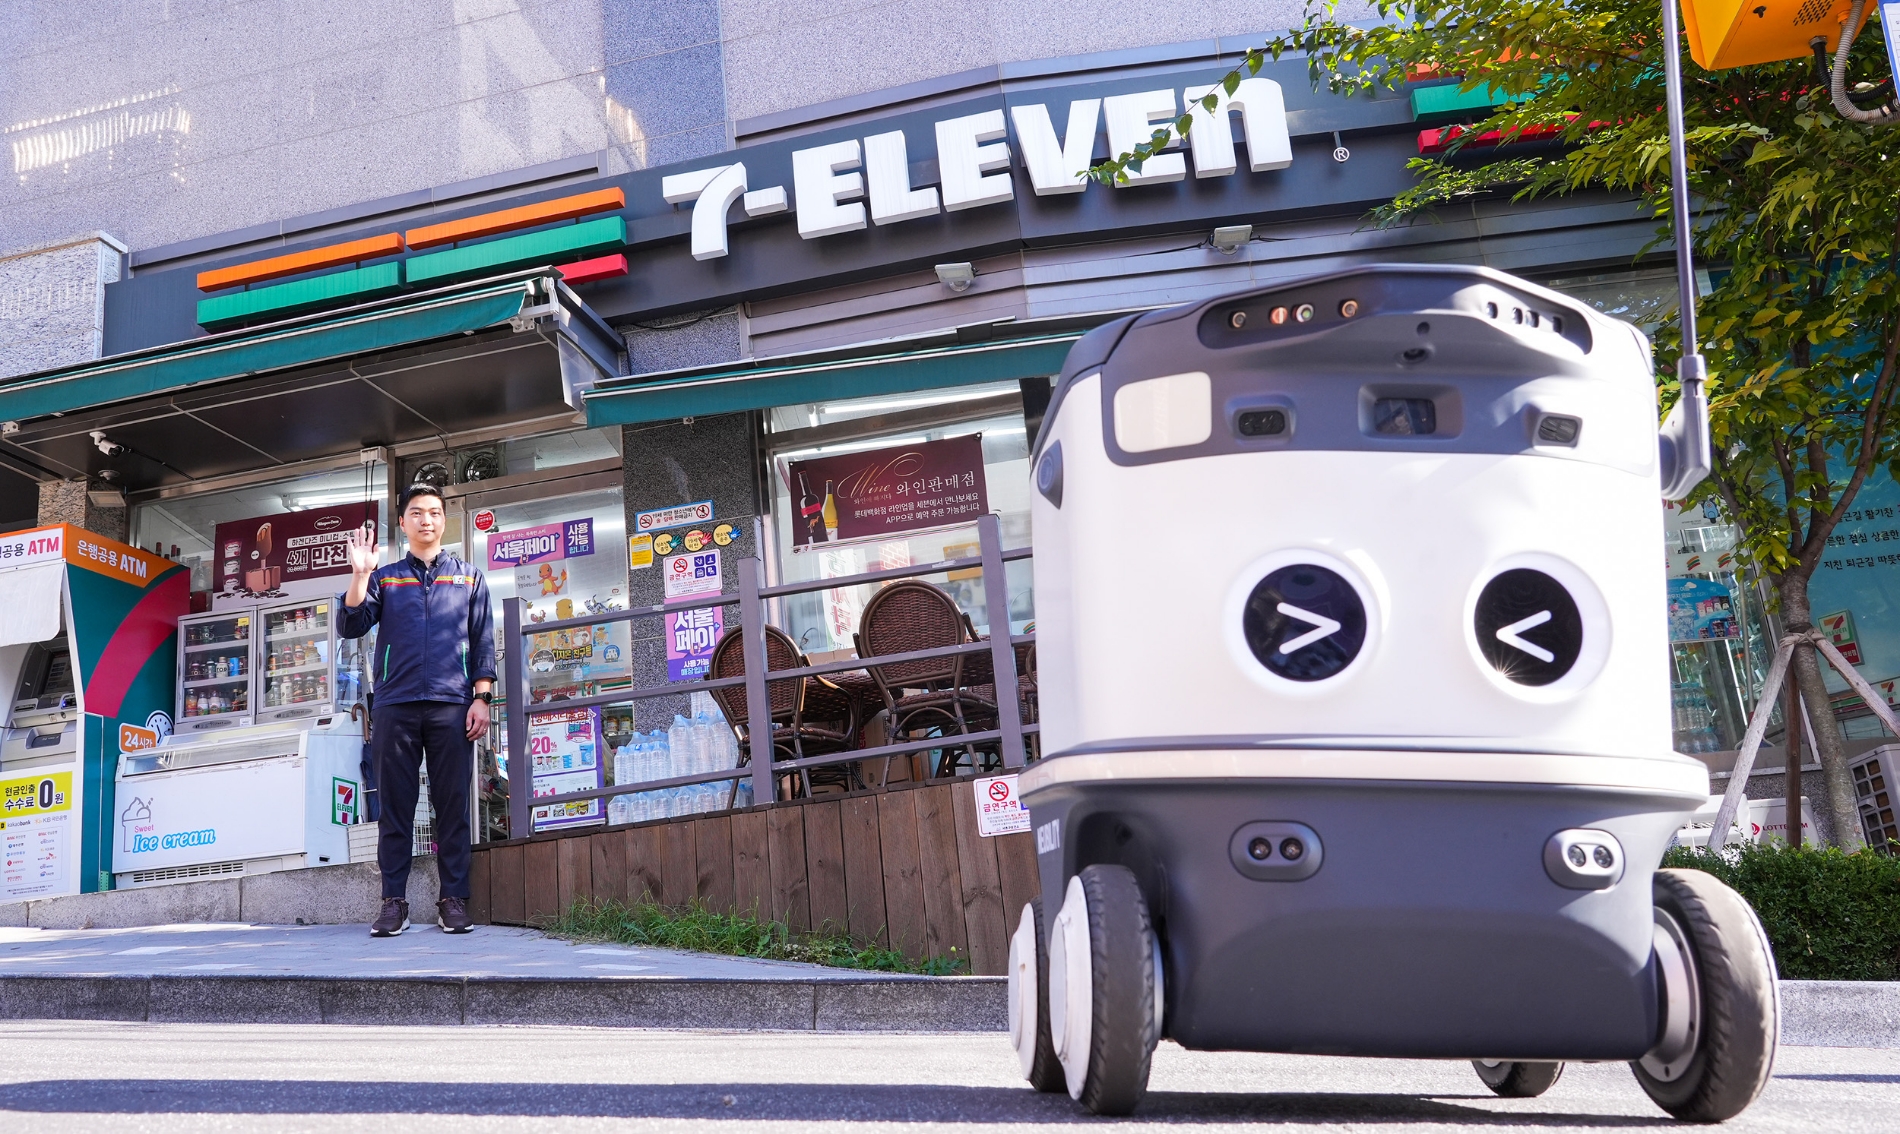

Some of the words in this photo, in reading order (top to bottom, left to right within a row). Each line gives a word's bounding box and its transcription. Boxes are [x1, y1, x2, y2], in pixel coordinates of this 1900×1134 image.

[837, 452, 924, 498] Wine
[896, 471, 975, 496] 와인판매점
[854, 506, 887, 519] 롯데백화점
[888, 501, 915, 514] 라인업을
[916, 497, 944, 509] 세븐에서
[944, 492, 979, 505] 만나보세요
[886, 513, 914, 524] APP으로
[916, 510, 929, 520] 예약
[931, 508, 945, 518] 주문
[946, 502, 980, 515] 가능합니다
[1838, 510, 1862, 523] 근길
[1865, 507, 1893, 520] 활기찬
[567, 523, 588, 536] 사용
[292, 536, 318, 546] 하겐다즈
[568, 534, 588, 546] 가능
[1826, 535, 1846, 546] 른한
[1848, 533, 1868, 544] 점심
[0, 543, 24, 559] 공용
[27, 536, 59, 556] ATM
[569, 545, 589, 554] 합니다
[77, 539, 118, 567] 은행공용
[120, 553, 147, 578] ATM
[287, 549, 308, 565] 4개
[312, 544, 352, 570] 만천
[1824, 560, 1843, 570] 지친
[1846, 556, 1875, 567] 퇴근길
[674, 607, 714, 630] 서울
[683, 659, 696, 668] 사용
[5, 783, 35, 797] 현금인출
[5, 796, 35, 811] 수수료
[983, 800, 1017, 813] 금연구역
[134, 824, 155, 833] Sweet
[133, 834, 158, 853] Ice
[162, 829, 216, 850] cream
